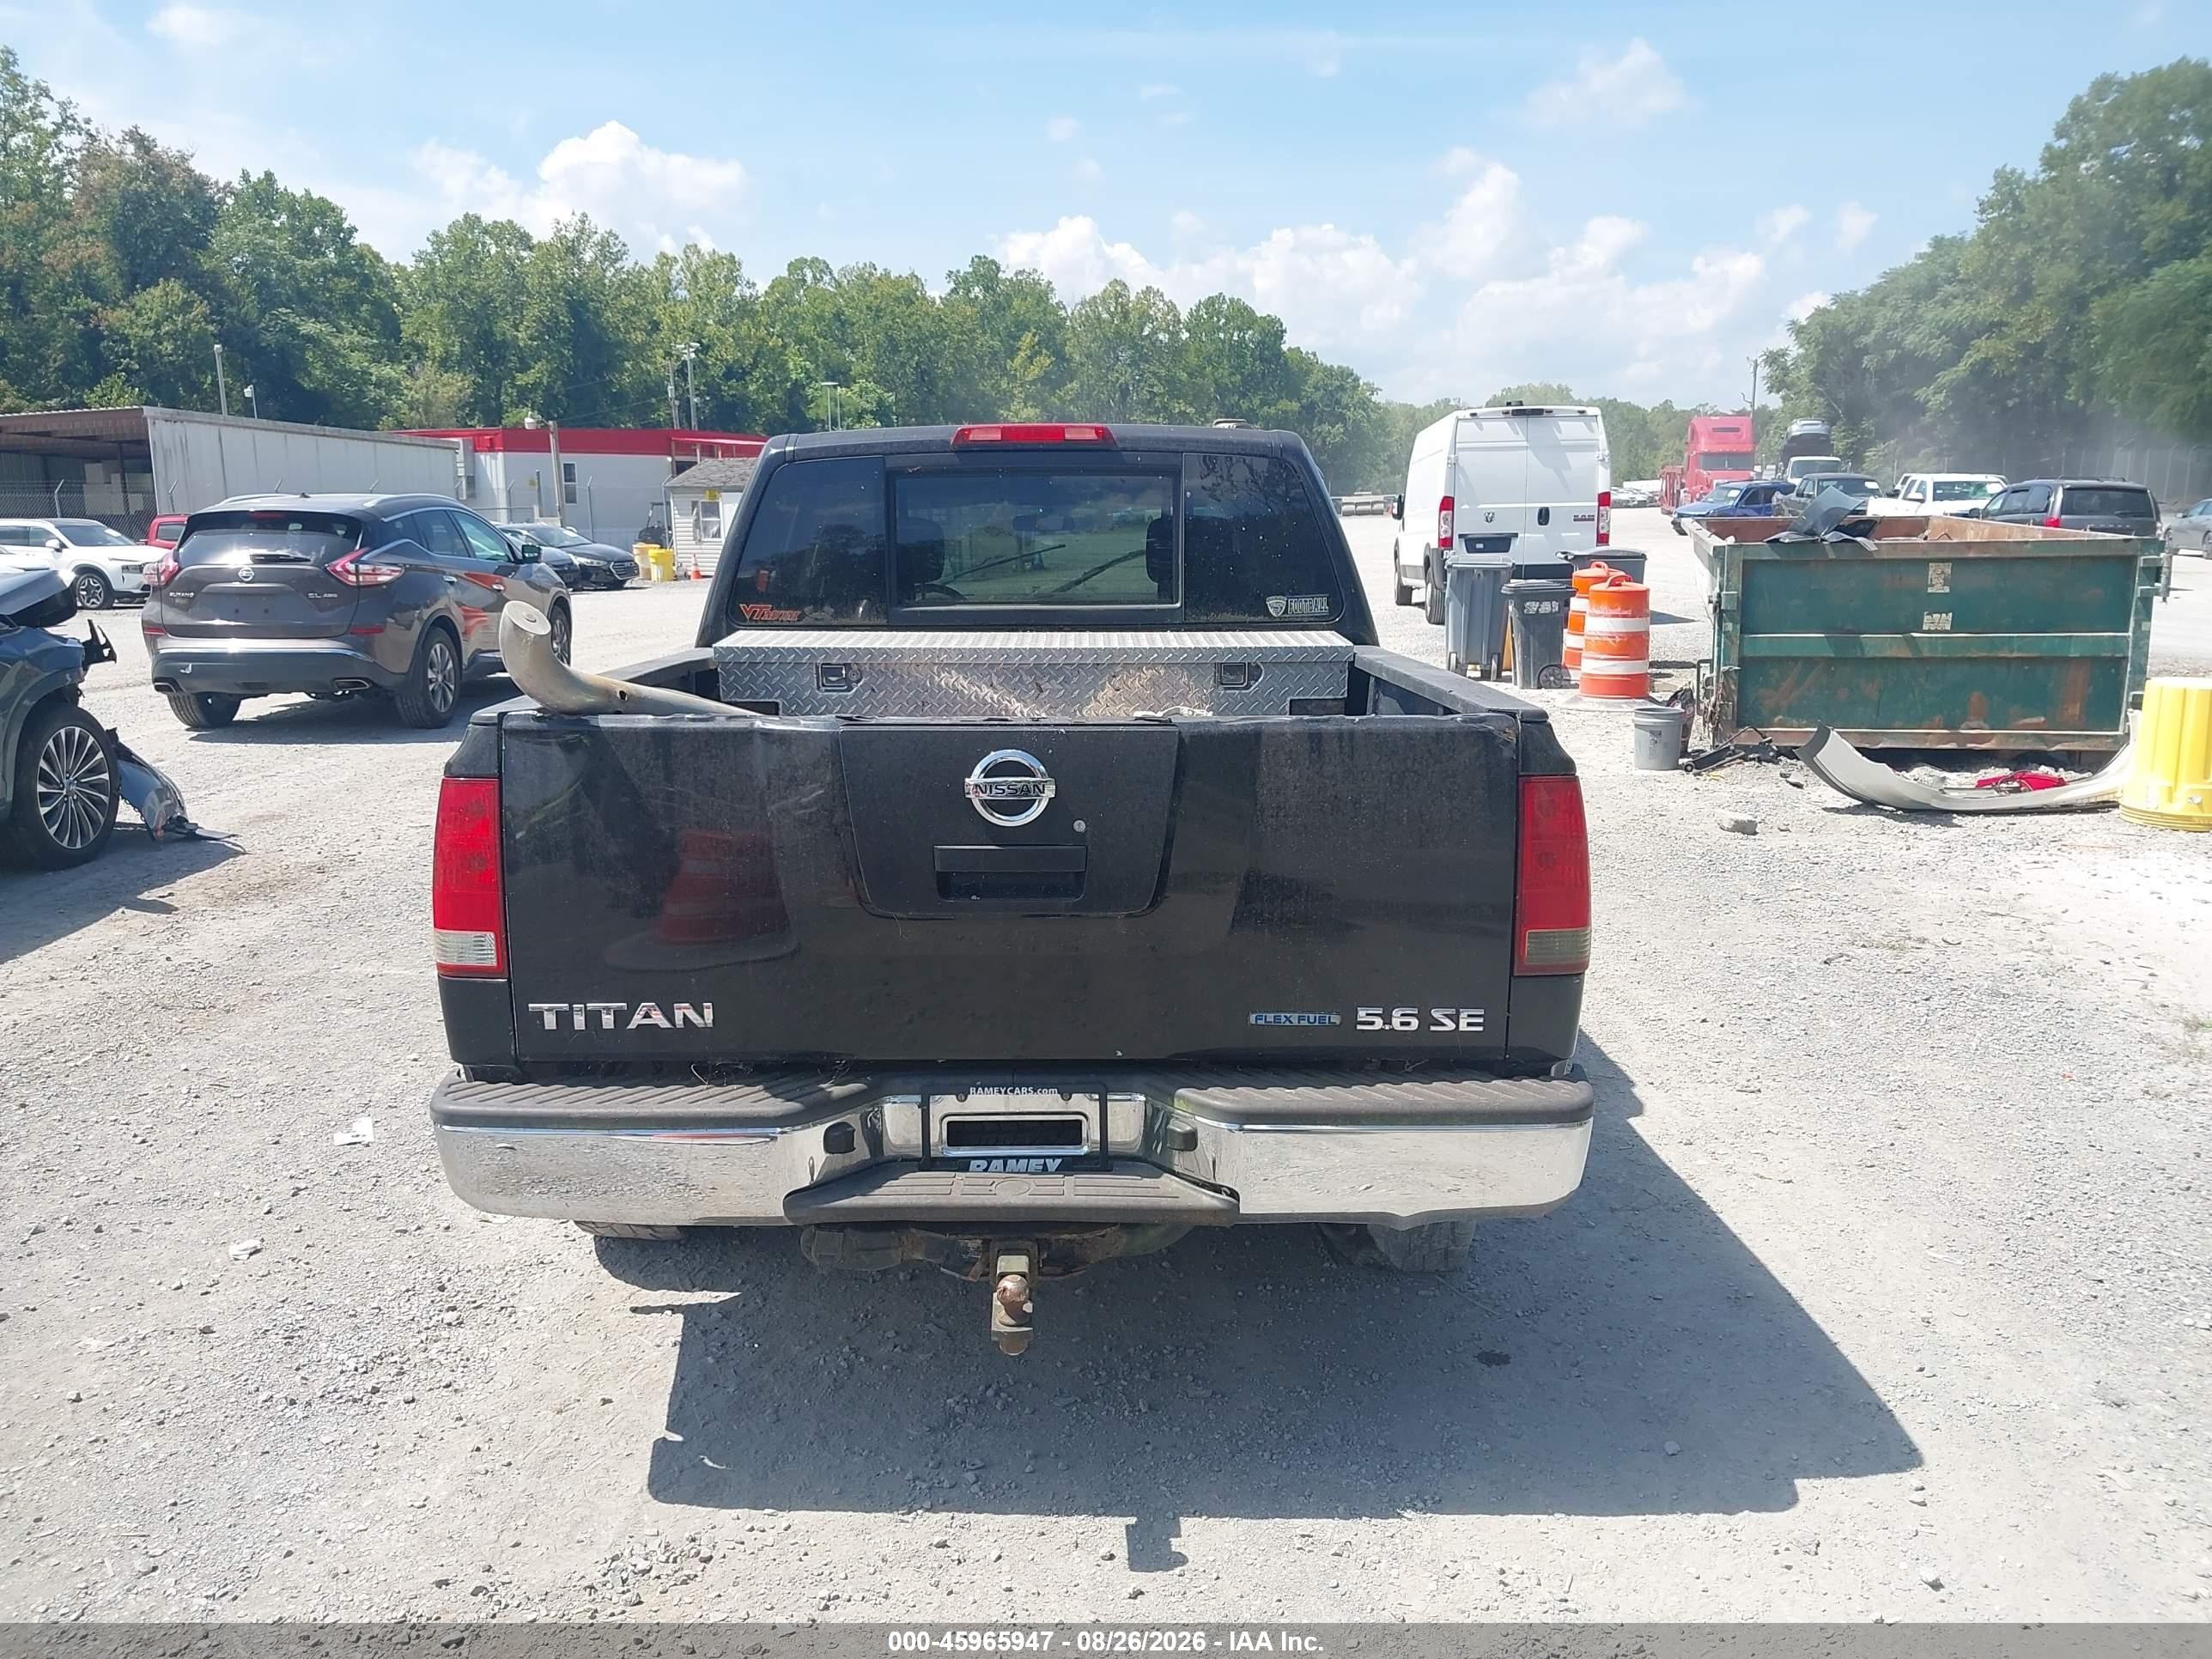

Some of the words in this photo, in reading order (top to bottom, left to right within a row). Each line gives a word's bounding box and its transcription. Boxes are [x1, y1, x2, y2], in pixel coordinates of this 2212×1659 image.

[1287, 597, 1329, 614] FOOTBALL
[975, 782, 1046, 795] NISSAN
[527, 1002, 714, 1030] TITAN
[1254, 1014, 1295, 1024] FLEX
[1297, 1014, 1337, 1024] FUEL
[1356, 1006, 1419, 1031] 5.6
[1429, 1007, 1485, 1031] SE
[969, 1086, 1058, 1096] RAMEYCARS.com
[969, 1158, 1063, 1172] RAMEY
